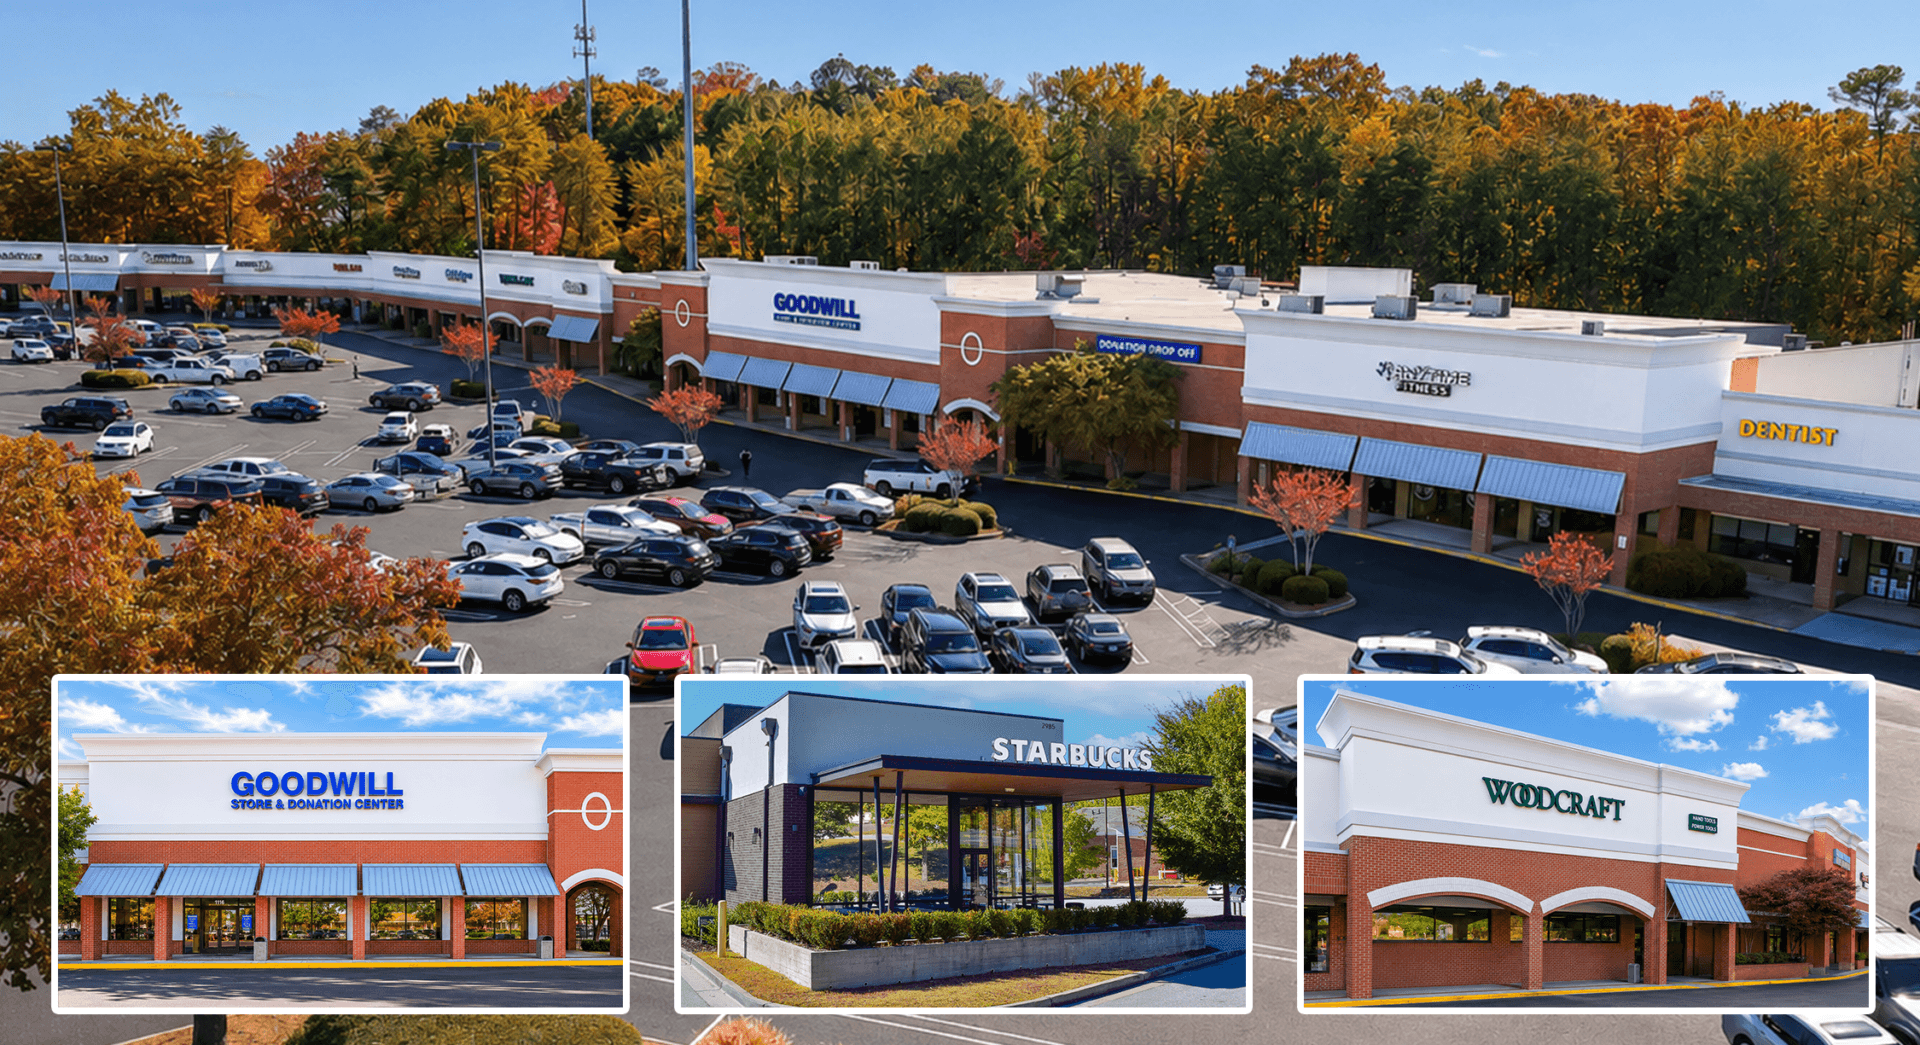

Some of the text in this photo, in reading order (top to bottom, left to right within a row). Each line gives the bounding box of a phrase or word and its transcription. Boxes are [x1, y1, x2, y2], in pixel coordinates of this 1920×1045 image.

[773, 292, 861, 319] GOODWILL
[1099, 339, 1196, 359] DONATION DROP OFF
[1739, 418, 1839, 446] DENTIST
[992, 737, 1153, 771] STARBUCKS
[231, 771, 404, 797] GOODWILL
[231, 798, 404, 810] STORE & DONATION CENTER
[1481, 776, 1626, 821] WOODCRAFT
